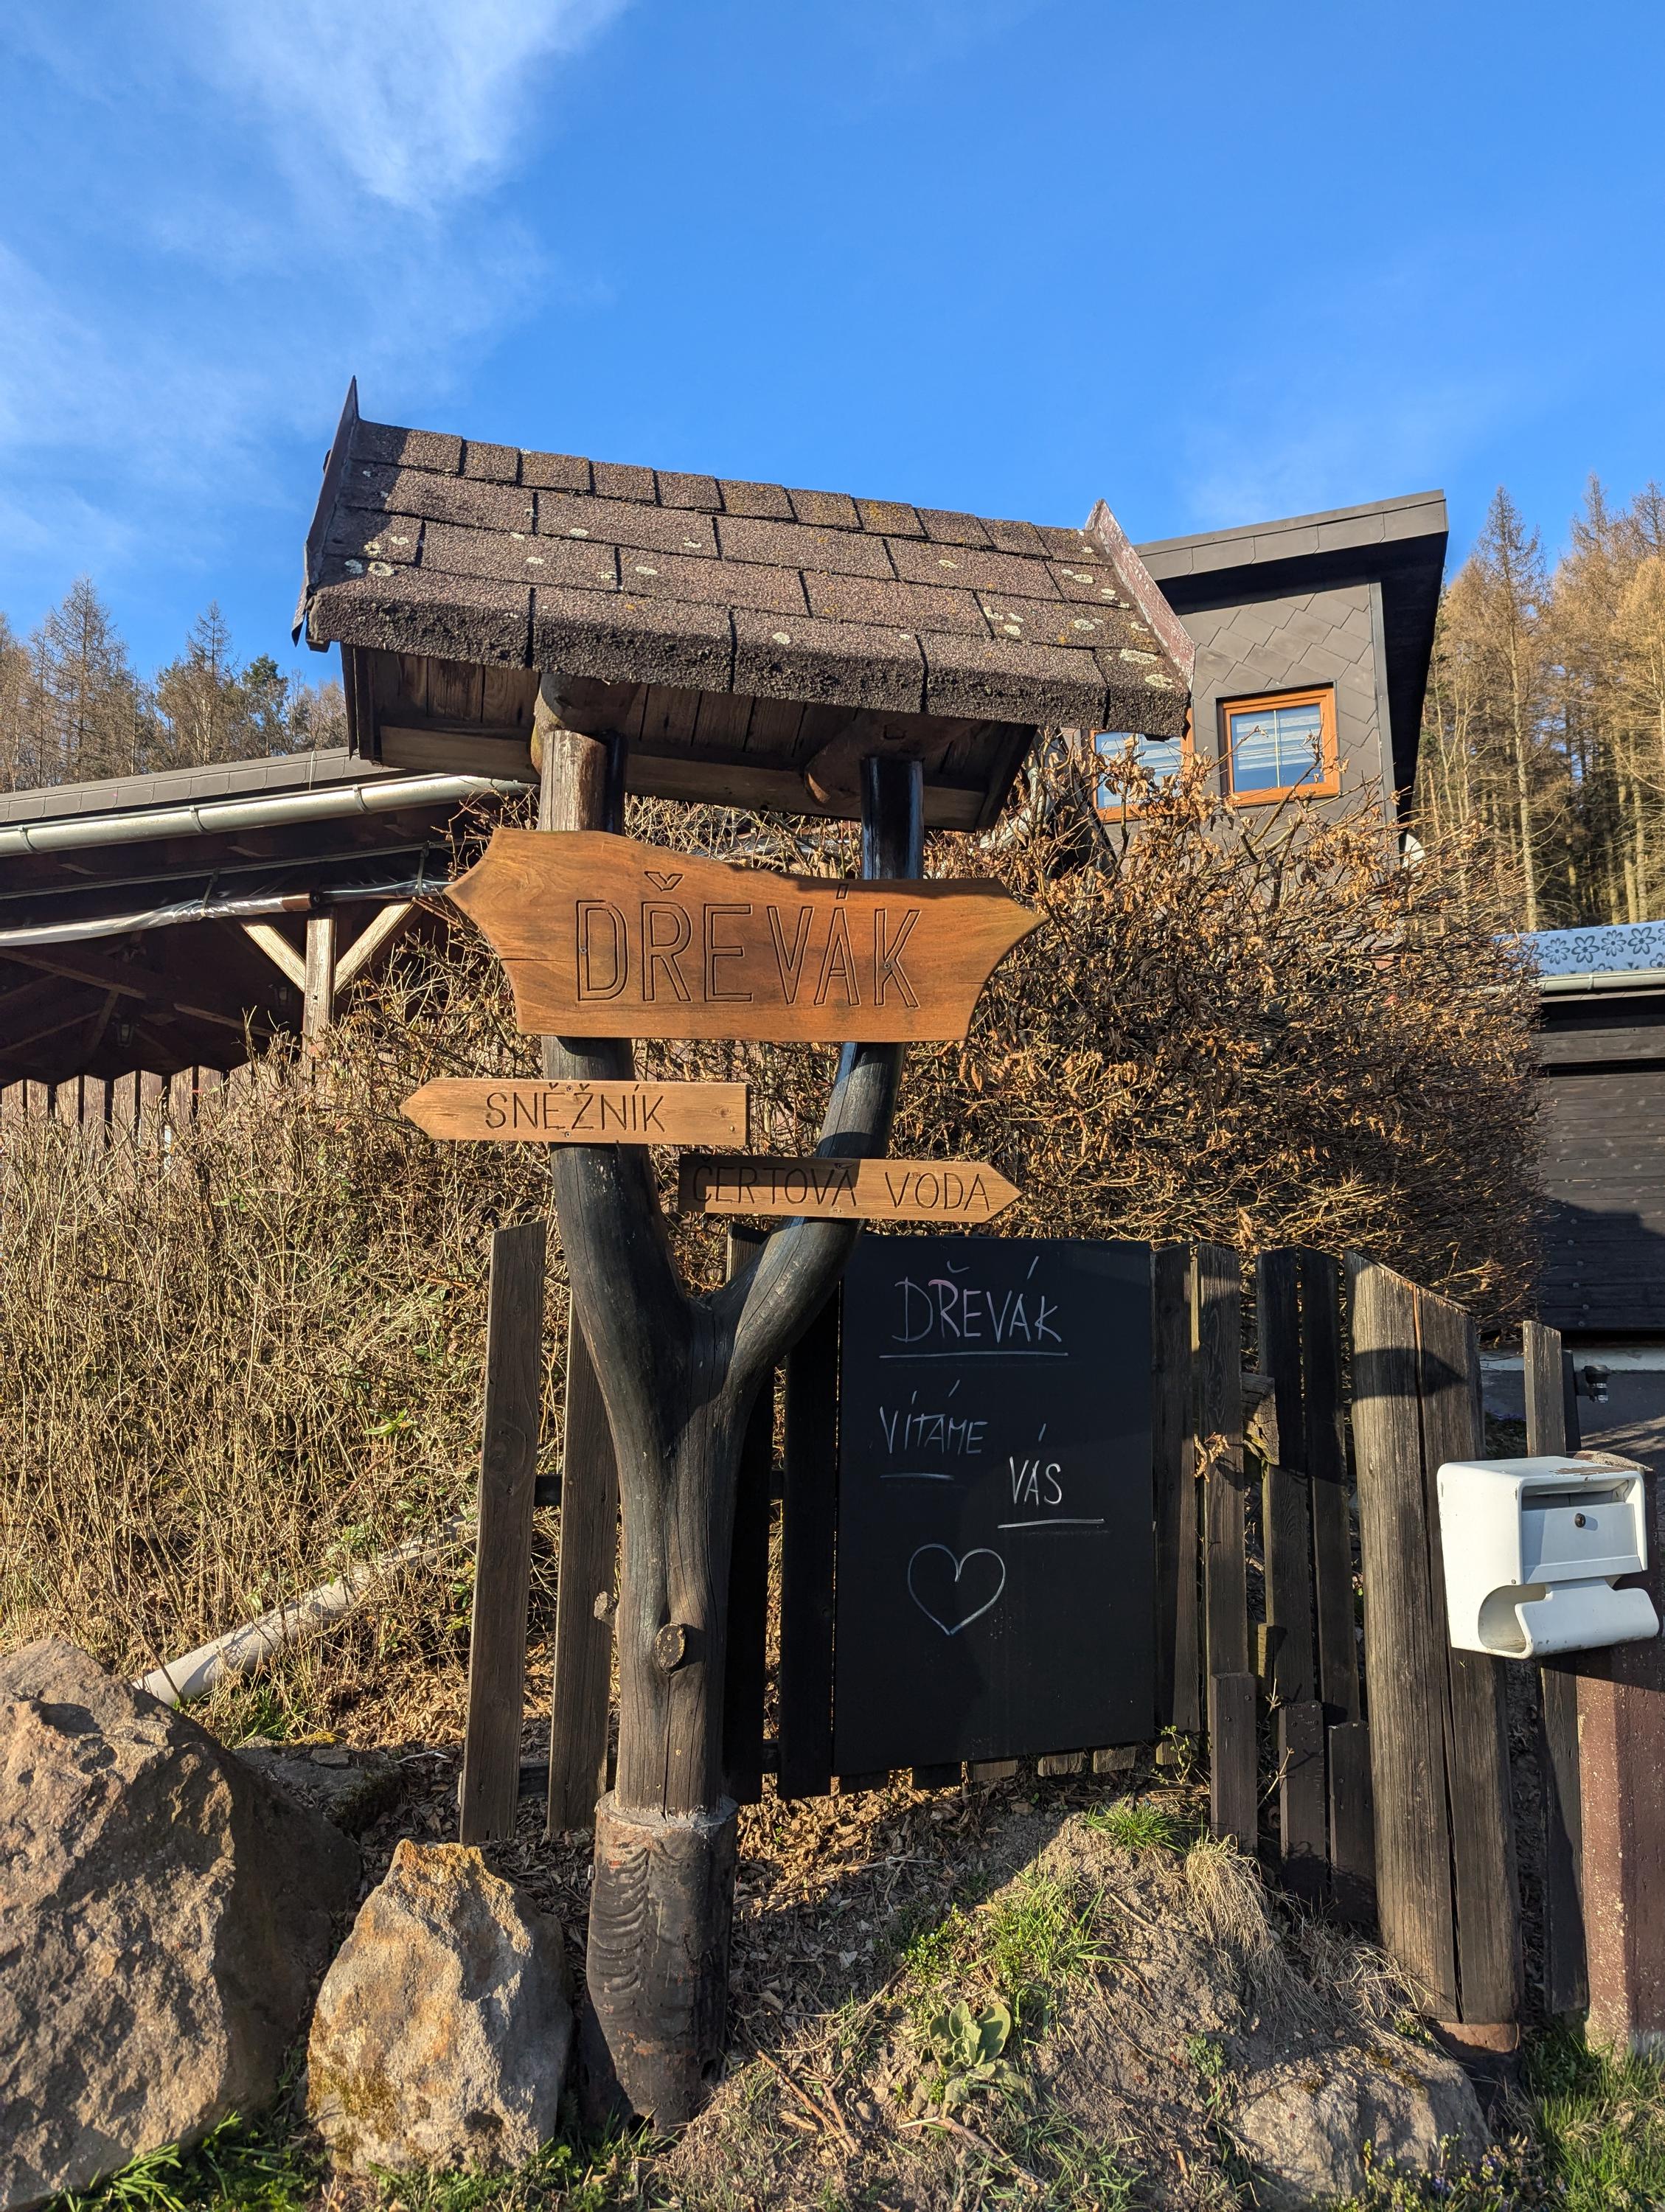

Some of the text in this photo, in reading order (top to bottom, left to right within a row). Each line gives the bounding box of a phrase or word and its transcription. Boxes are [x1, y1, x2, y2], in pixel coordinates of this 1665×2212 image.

[575, 871, 922, 1009] DŘEVÁK
[484, 1082, 666, 1133] SNĚŽNÍK
[884, 1171, 990, 1211] VODA
[891, 1256, 1063, 1343] DŘEVÁK
[879, 1380, 989, 1455] VÍTÁME
[1009, 1423, 1063, 1507] VÁS
